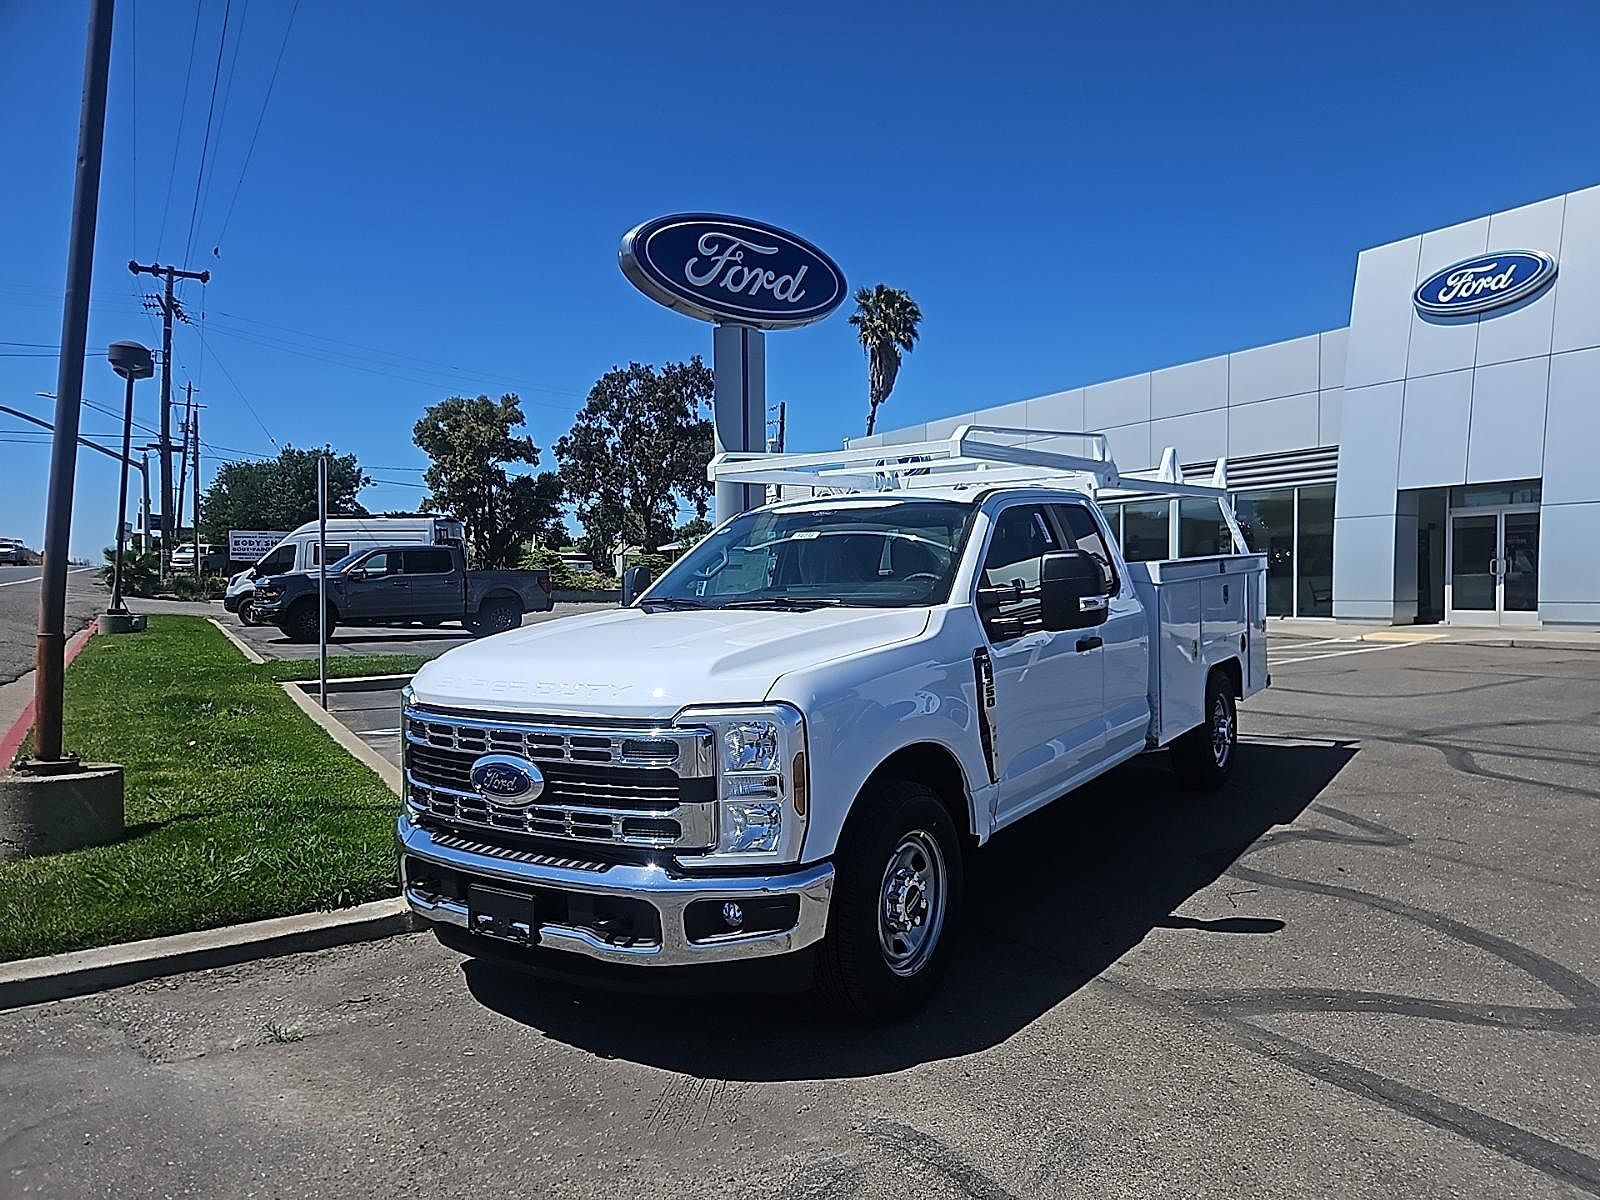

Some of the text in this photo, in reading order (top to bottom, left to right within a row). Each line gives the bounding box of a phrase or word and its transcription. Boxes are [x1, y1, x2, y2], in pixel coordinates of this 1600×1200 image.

[685, 232, 808, 302] Ford
[1438, 263, 1517, 302] Ford
[483, 768, 517, 791] Ford
